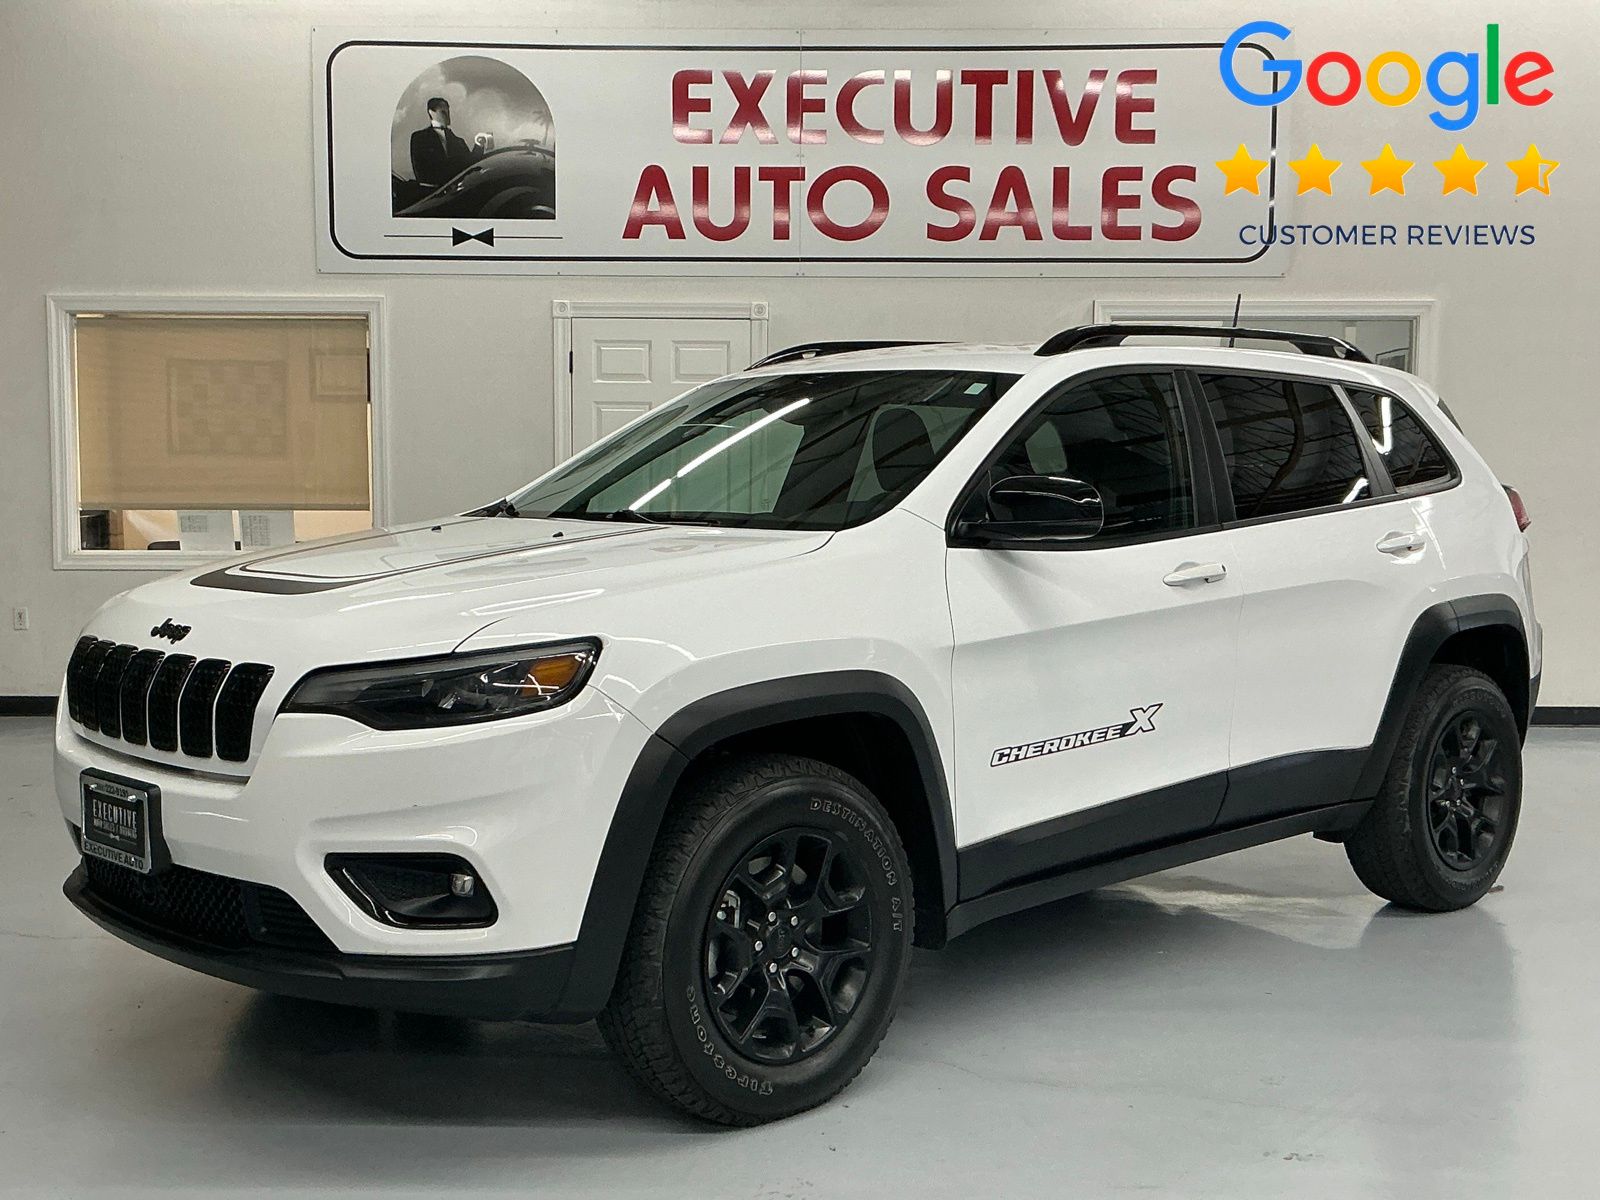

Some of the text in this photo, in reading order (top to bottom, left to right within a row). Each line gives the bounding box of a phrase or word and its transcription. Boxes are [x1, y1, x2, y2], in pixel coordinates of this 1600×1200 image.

[671, 69, 1158, 147] EXECUTIVE
[622, 164, 1202, 242] AUTO SALES
[990, 702, 1164, 768] CHEROKEE X
[92, 798, 138, 830] EXECUTIVE
[810, 797, 898, 886] DESTINATION
[84, 841, 124, 863] EXECUTIVE
